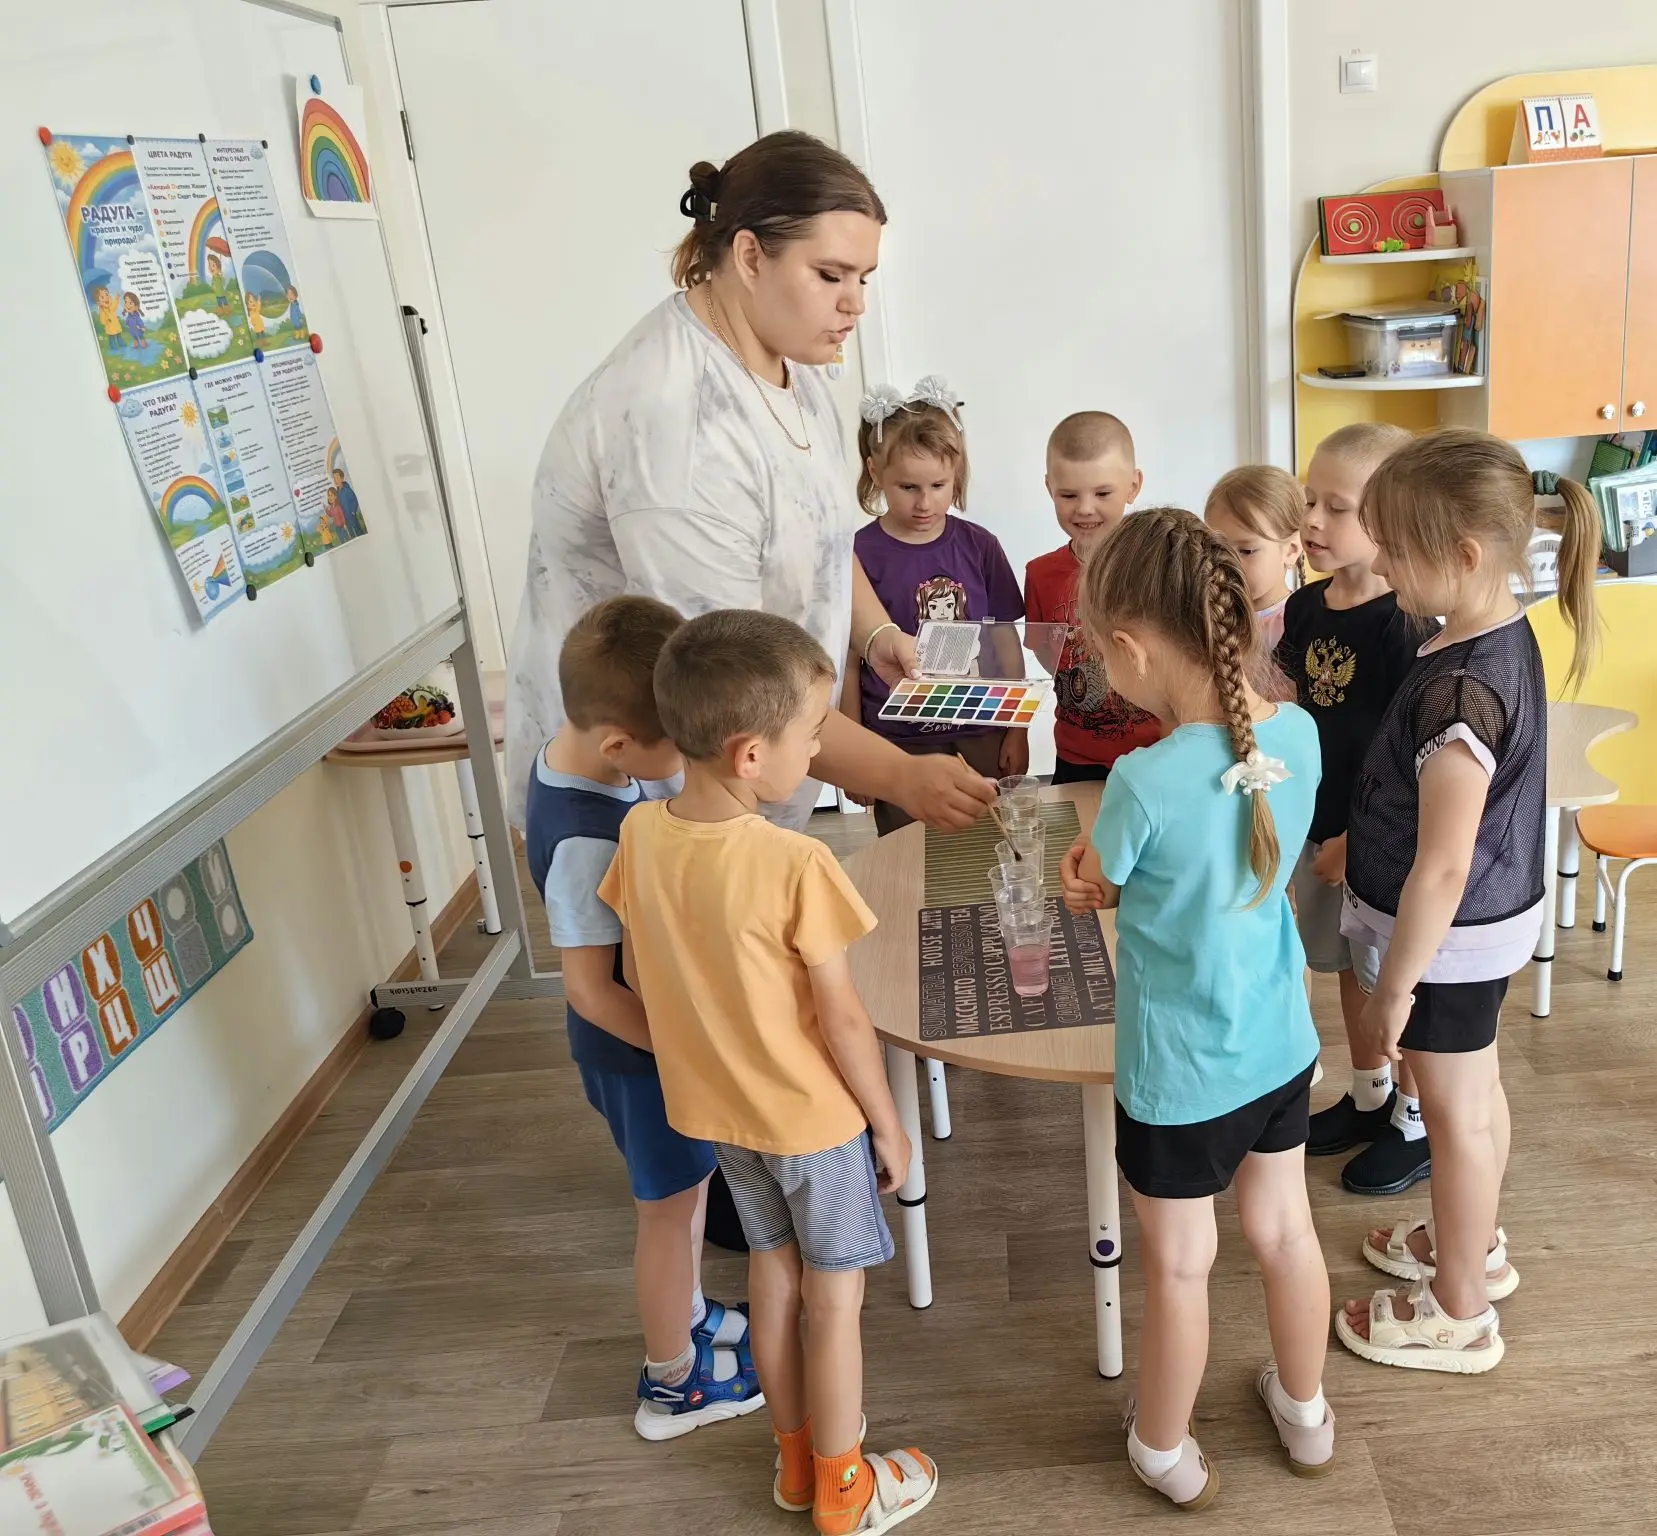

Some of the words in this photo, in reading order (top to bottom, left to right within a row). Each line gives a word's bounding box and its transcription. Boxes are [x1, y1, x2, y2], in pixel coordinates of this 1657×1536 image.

[1534, 105, 1553, 131] П
[1574, 104, 1591, 128] А
[81, 205, 135, 223] РАДУГА
[91, 226, 120, 235] красота
[128, 225, 143, 233] чудо
[104, 235, 137, 246] природы!
[143, 398, 156, 407] ЧТО
[157, 392, 178, 402] ТАКОЕ
[149, 404, 176, 417] РАДУГА?
[133, 903, 158, 950] Ч
[921, 910, 943, 931] LATTE
[950, 907, 971, 924] TEA
[978, 904, 1005, 966] CAPPUCCINO
[1071, 911, 1101, 951] CAPPUC
[87, 939, 117, 996] Х
[922, 934, 943, 967] HOUSE
[950, 923, 976, 977] ESPRESSO
[1048, 931, 1071, 970] LATTE
[1080, 950, 1108, 976] MILK
[49, 968, 80, 1028] Н
[144, 953, 180, 1011] Щ
[984, 967, 1013, 1031] ESPRESSO
[1050, 971, 1082, 1023] CARAMEL
[1086, 977, 1116, 1020] LATTE
[104, 996, 133, 1045] Ц
[922, 971, 946, 1038] SUMATRA
[953, 977, 980, 1035] MACCHIATO
[68, 1031, 90, 1083] Р
[1371, 1077, 1389, 1088] NIKE
[1408, 1114, 1421, 1122] NI
